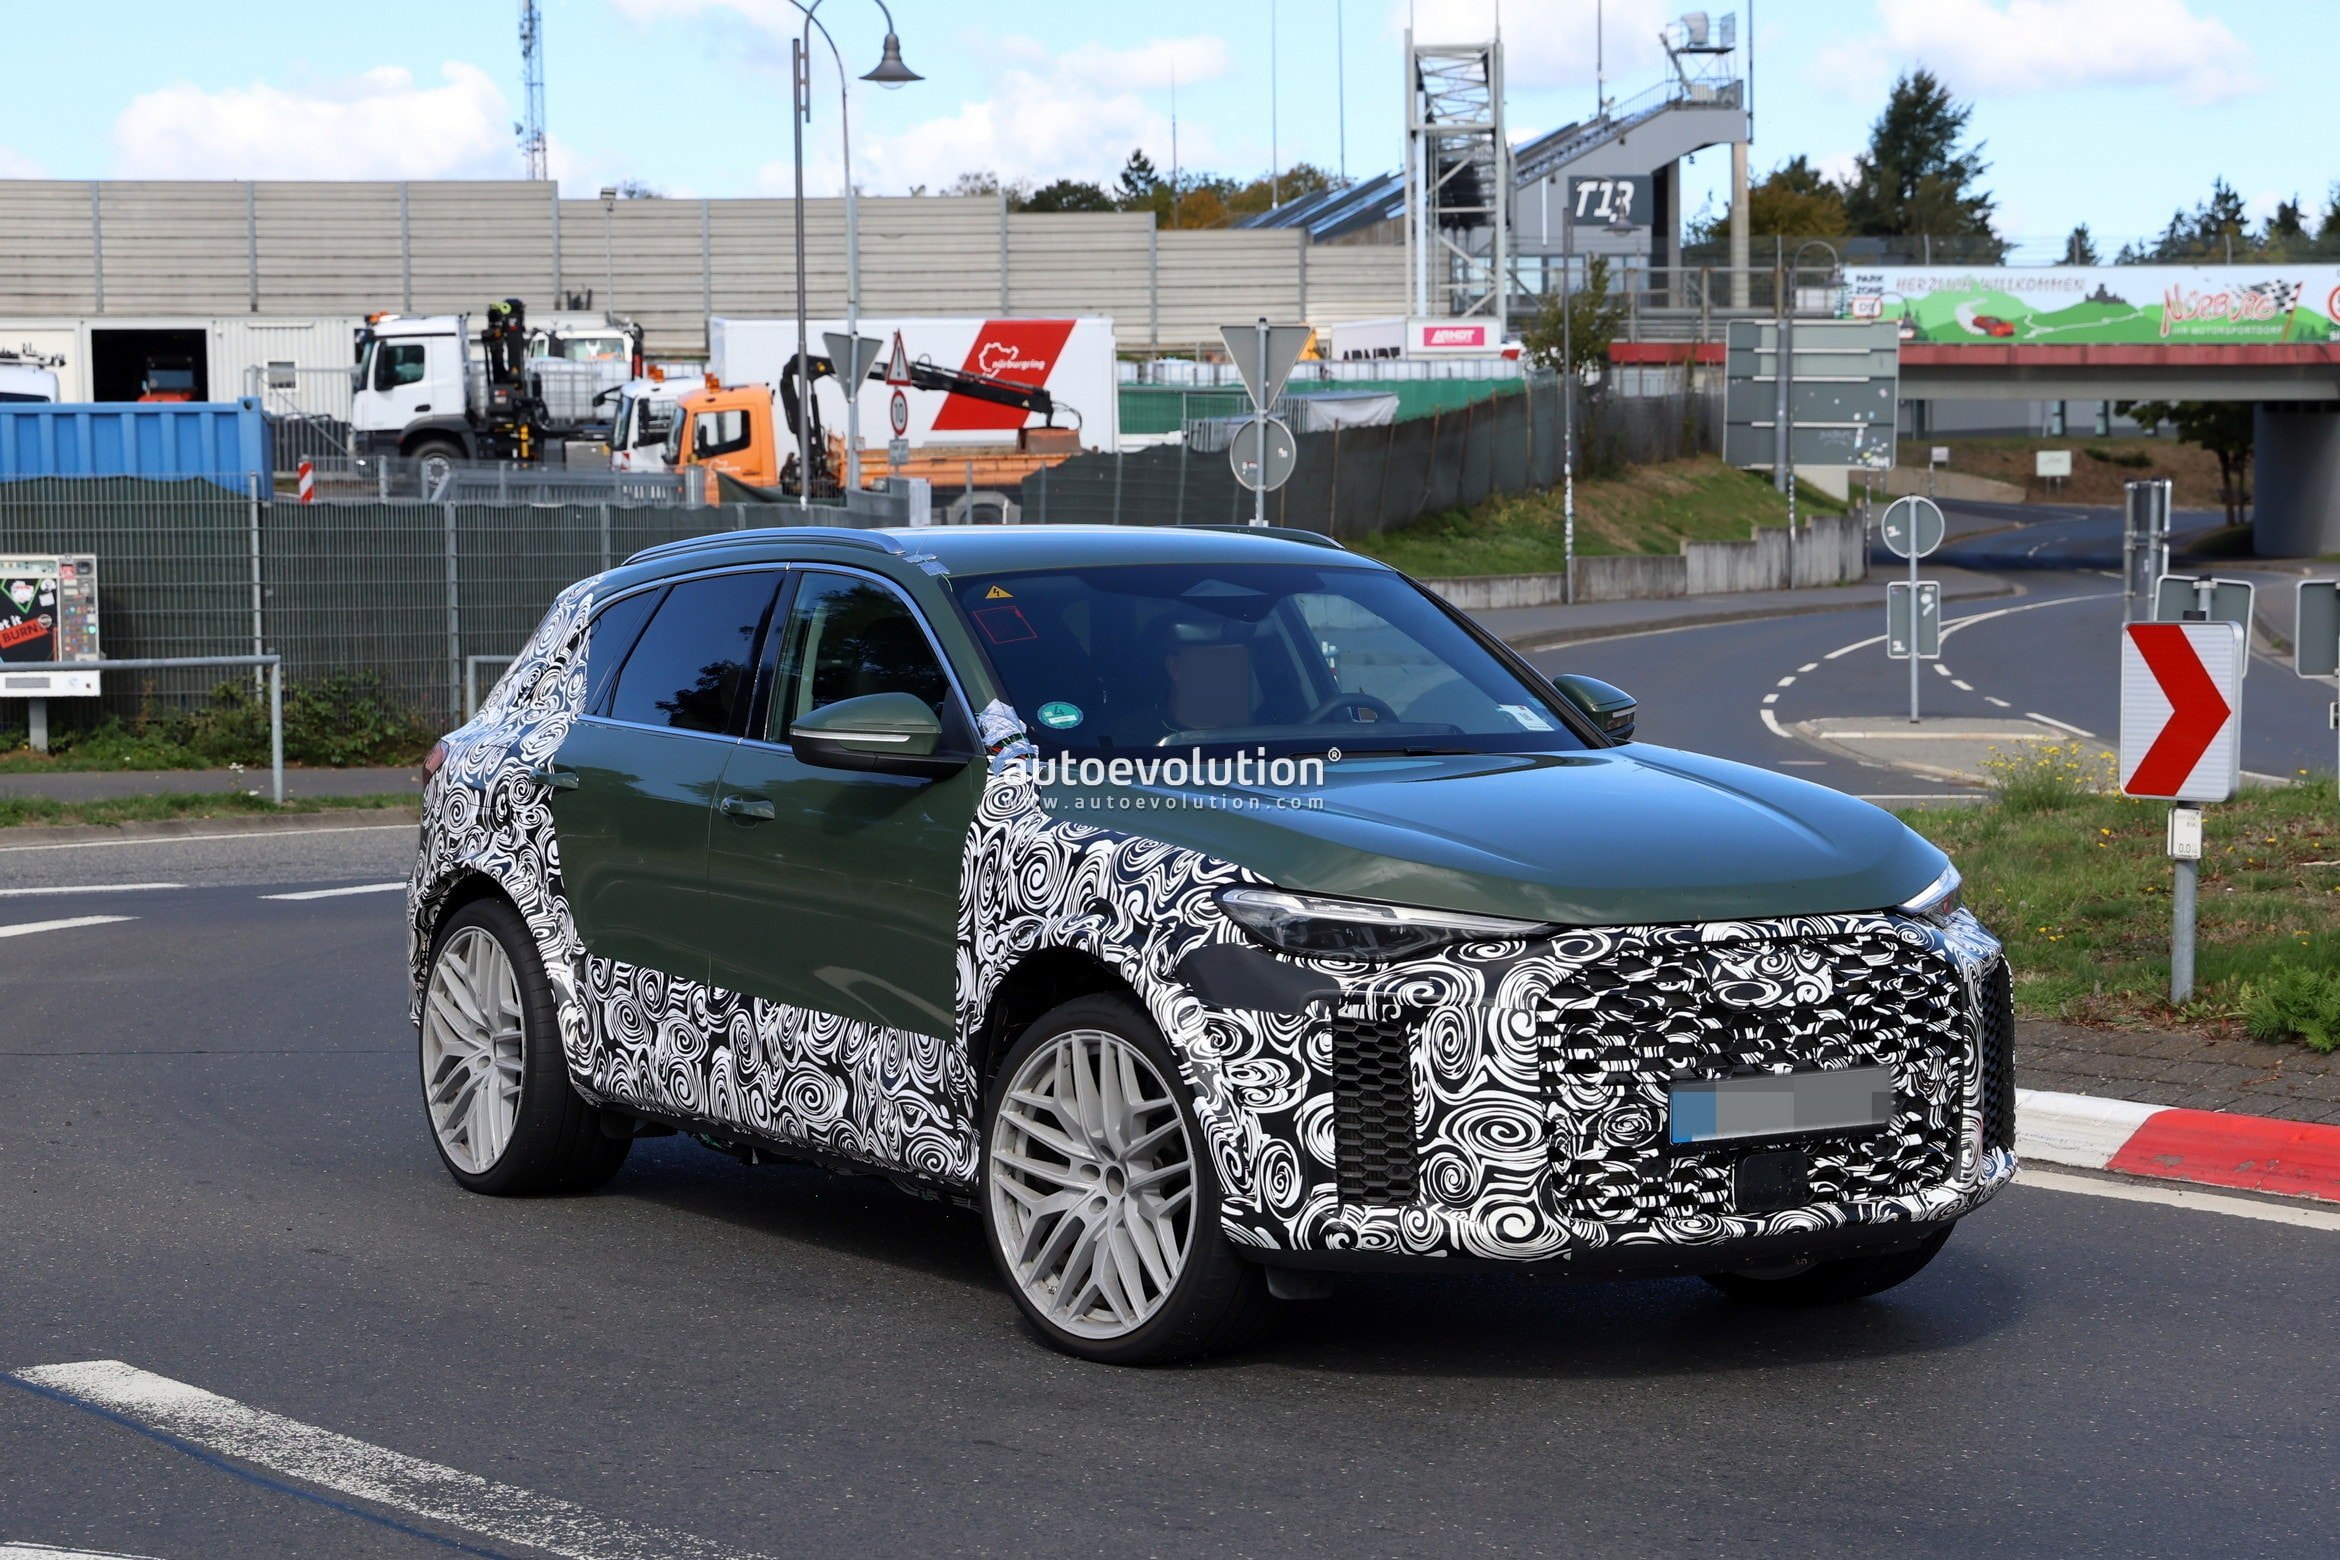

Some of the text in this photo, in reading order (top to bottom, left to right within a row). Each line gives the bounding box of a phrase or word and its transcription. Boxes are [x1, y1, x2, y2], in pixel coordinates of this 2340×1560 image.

[1980, 277, 2086, 292] WILLKOMMEN
[2, 623, 39, 643] BURN
[1054, 705, 1065, 716] 4
